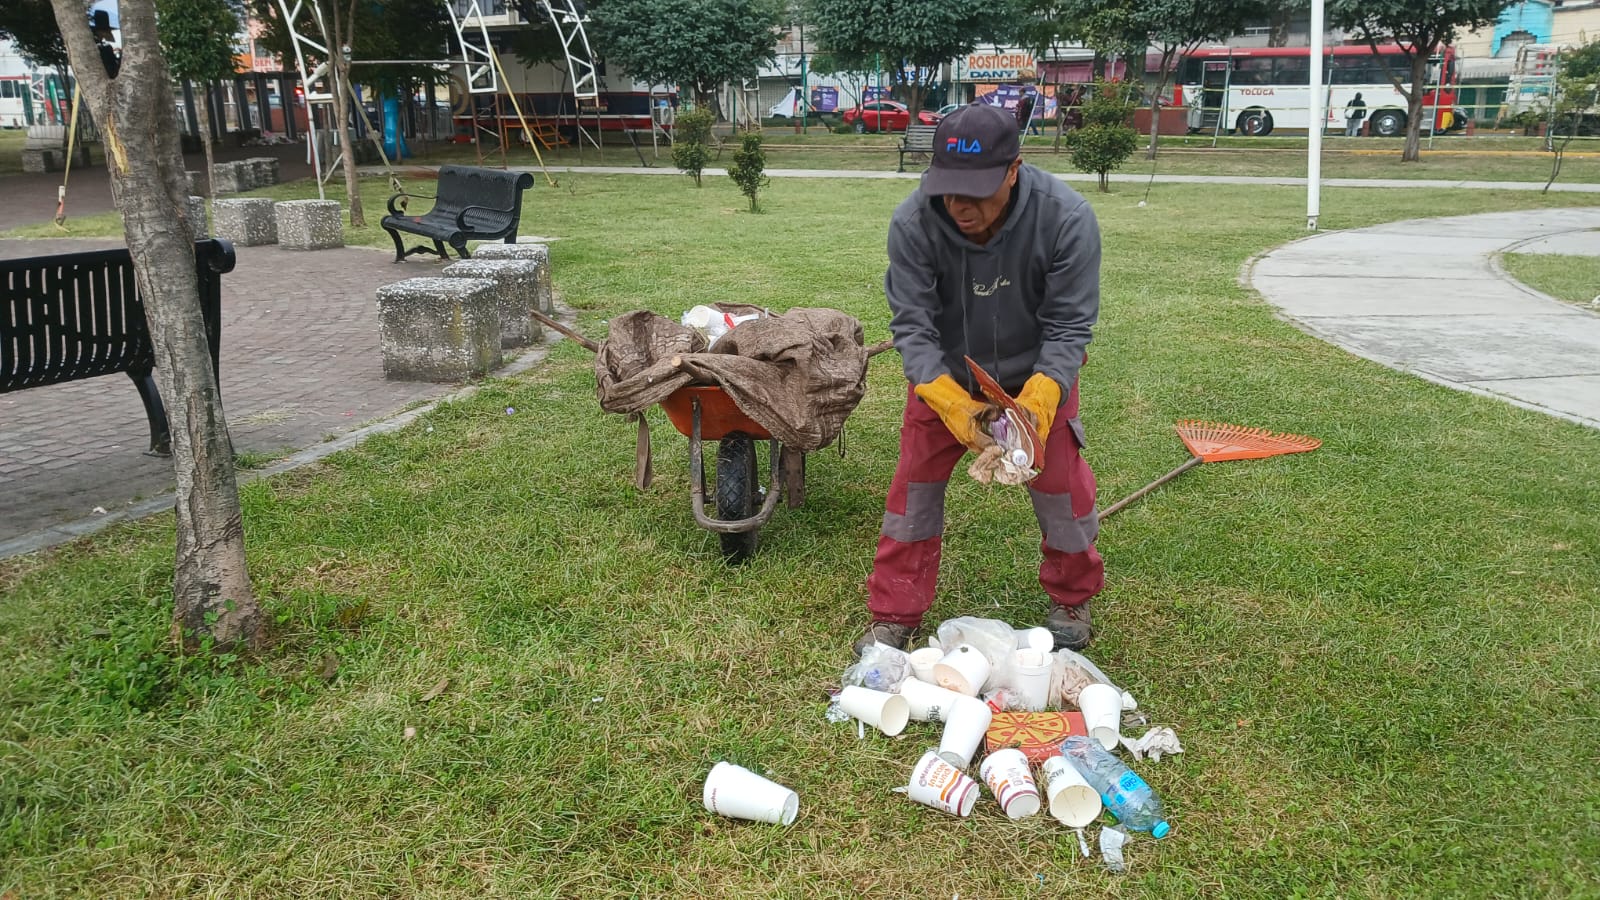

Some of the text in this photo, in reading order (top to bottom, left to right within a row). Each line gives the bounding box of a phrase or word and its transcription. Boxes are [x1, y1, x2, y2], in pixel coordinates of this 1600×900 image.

[969, 54, 1034, 69] ROSTICERIA
[969, 70, 1016, 78] DANY
[1240, 87, 1275, 96] TOLUCA
[946, 137, 982, 153] FILA
[1122, 776, 1138, 791] ciel
